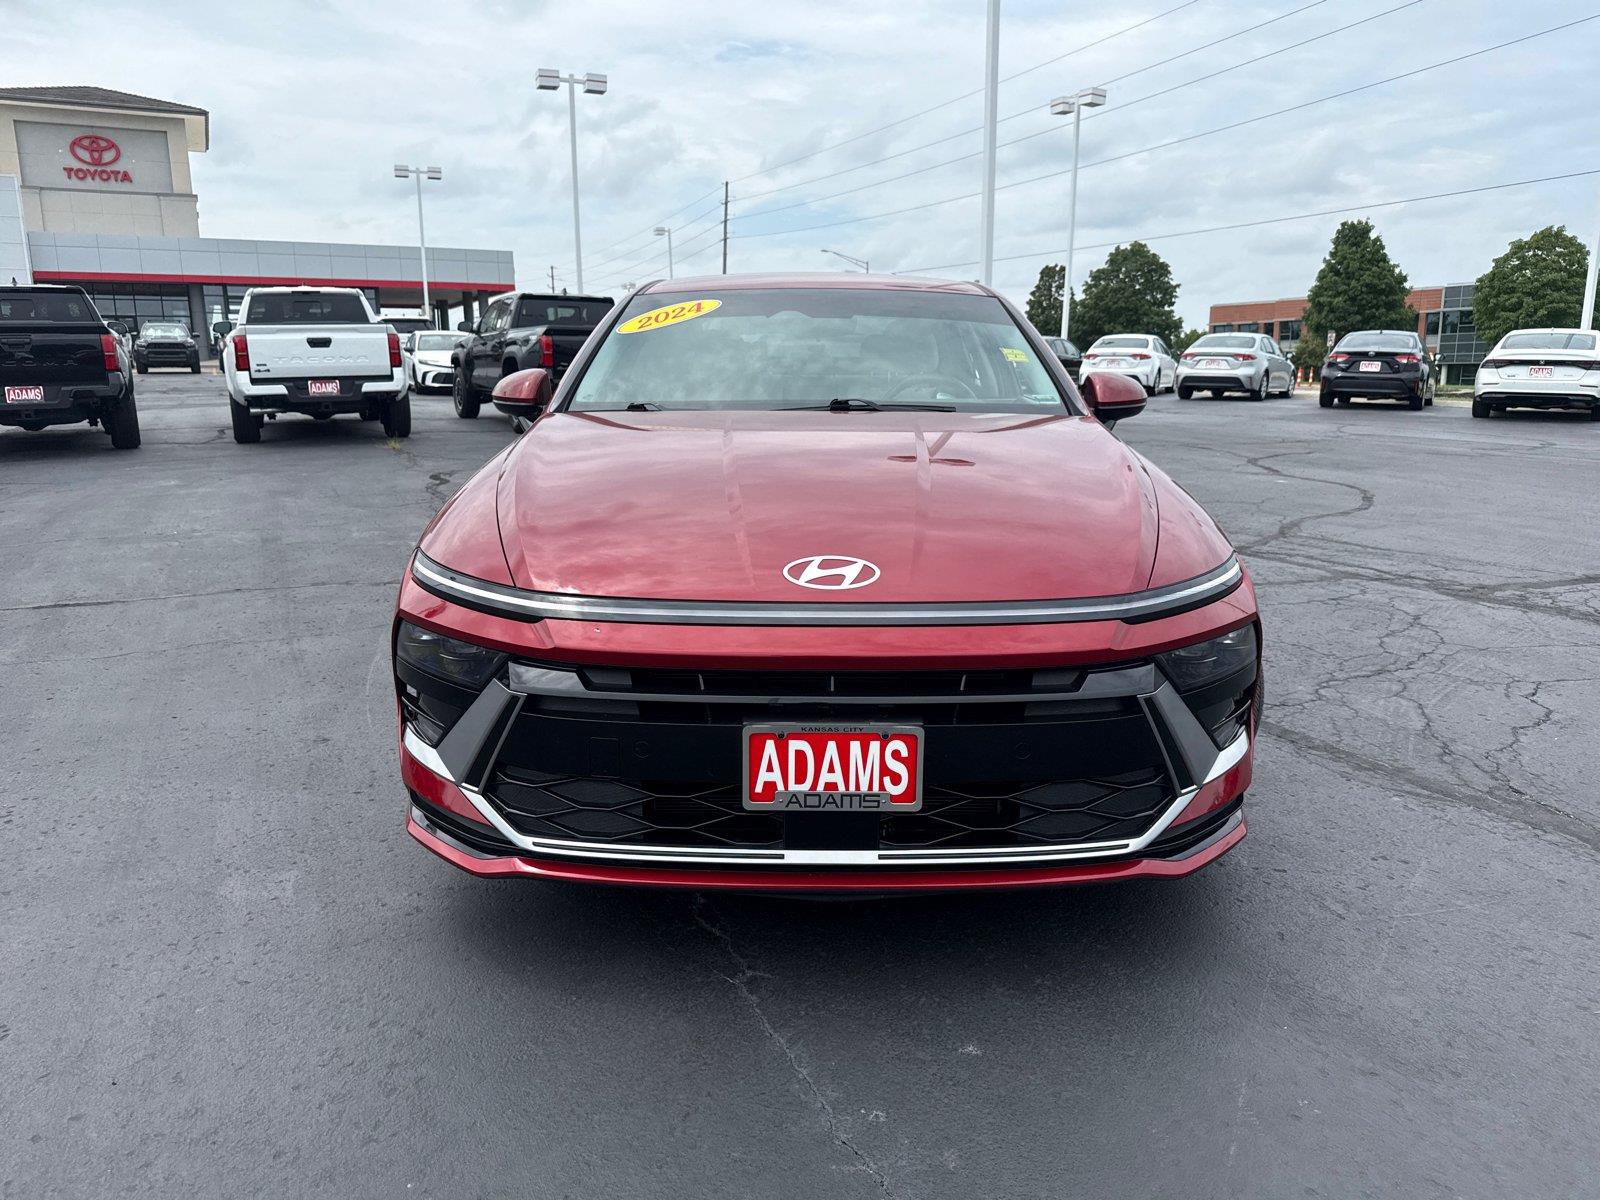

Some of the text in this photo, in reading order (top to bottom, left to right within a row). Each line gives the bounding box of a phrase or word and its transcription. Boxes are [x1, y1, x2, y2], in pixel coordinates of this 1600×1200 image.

[63, 167, 132, 183] TOYOTA
[637, 302, 703, 329] 2024
[9, 389, 42, 400] ADAMS
[311, 382, 337, 393] ADAMS
[754, 739, 909, 795] ADAMS
[785, 793, 881, 808] ADAMS
